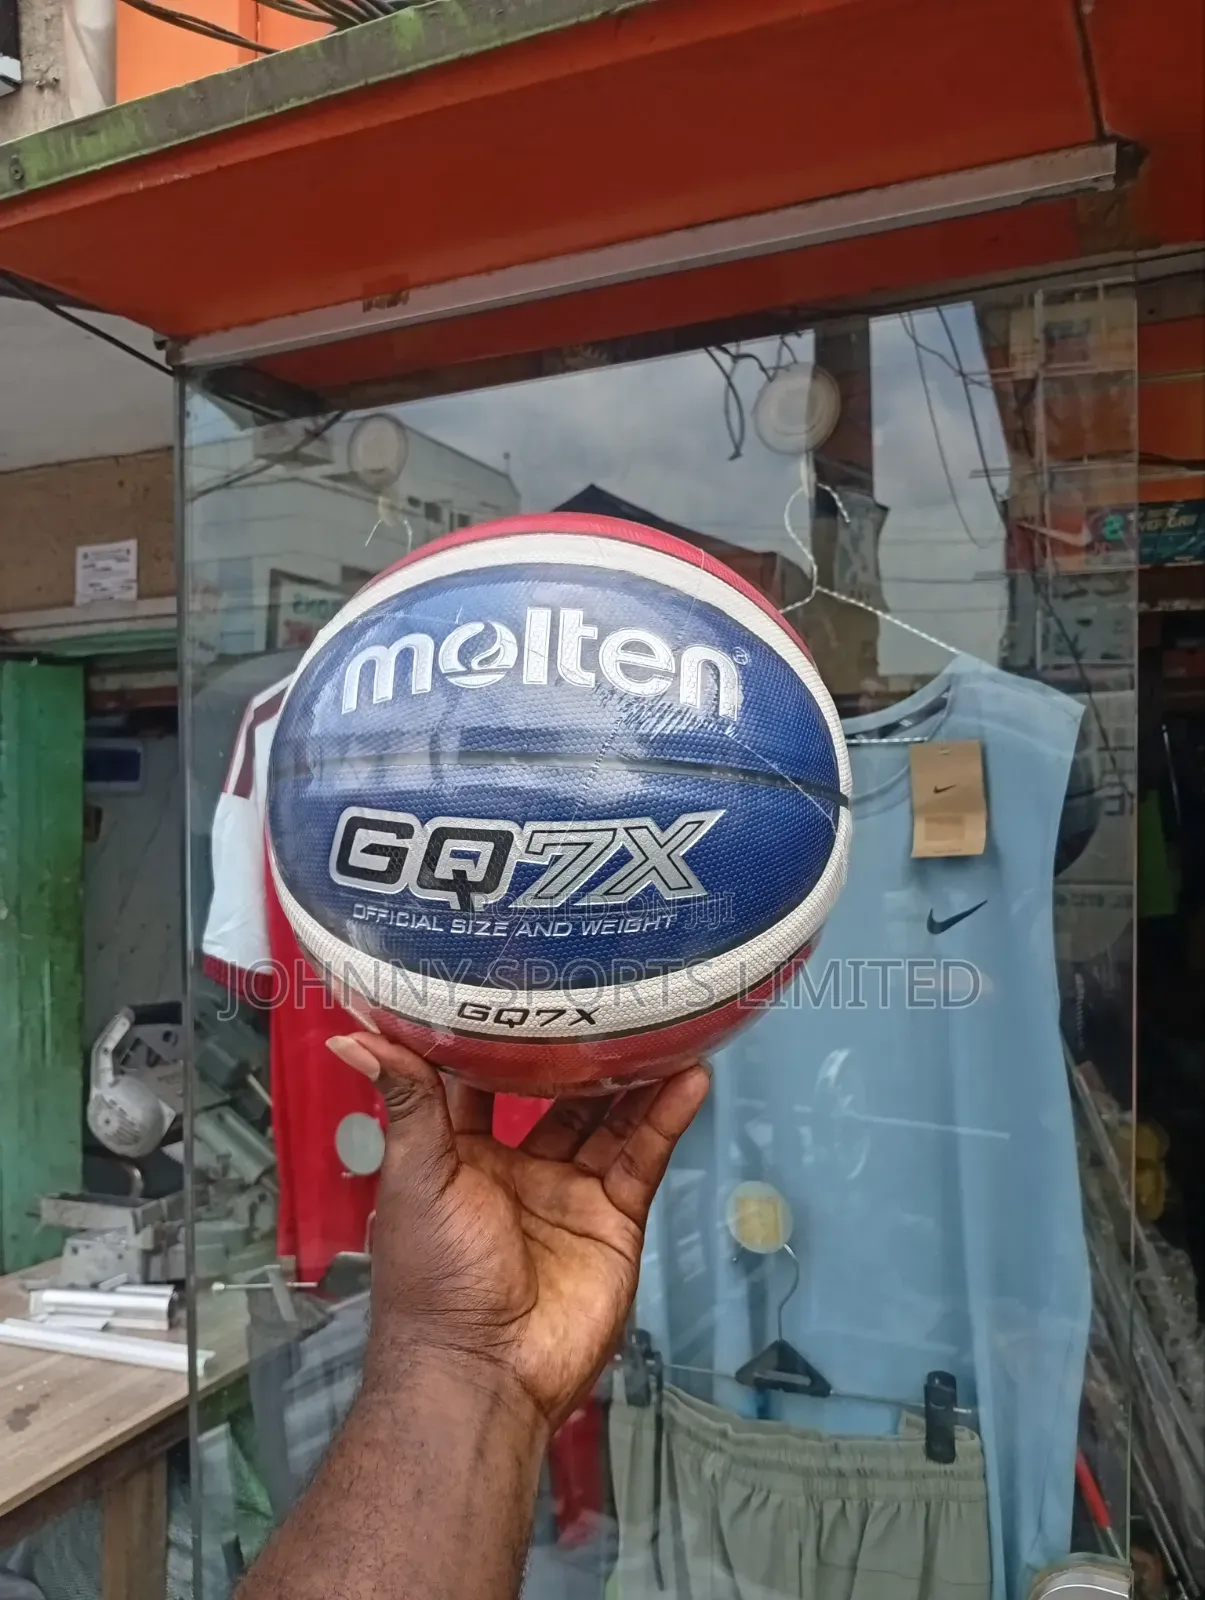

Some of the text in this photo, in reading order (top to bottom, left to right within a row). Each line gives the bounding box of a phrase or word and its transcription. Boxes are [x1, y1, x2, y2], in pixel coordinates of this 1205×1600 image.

[341, 606, 739, 721] molten
[329, 806, 726, 912] GQ7X
[353, 903, 678, 937] OFFICIAL SIZE AND WEIGHT
[457, 1001, 599, 1028] GQ7X
